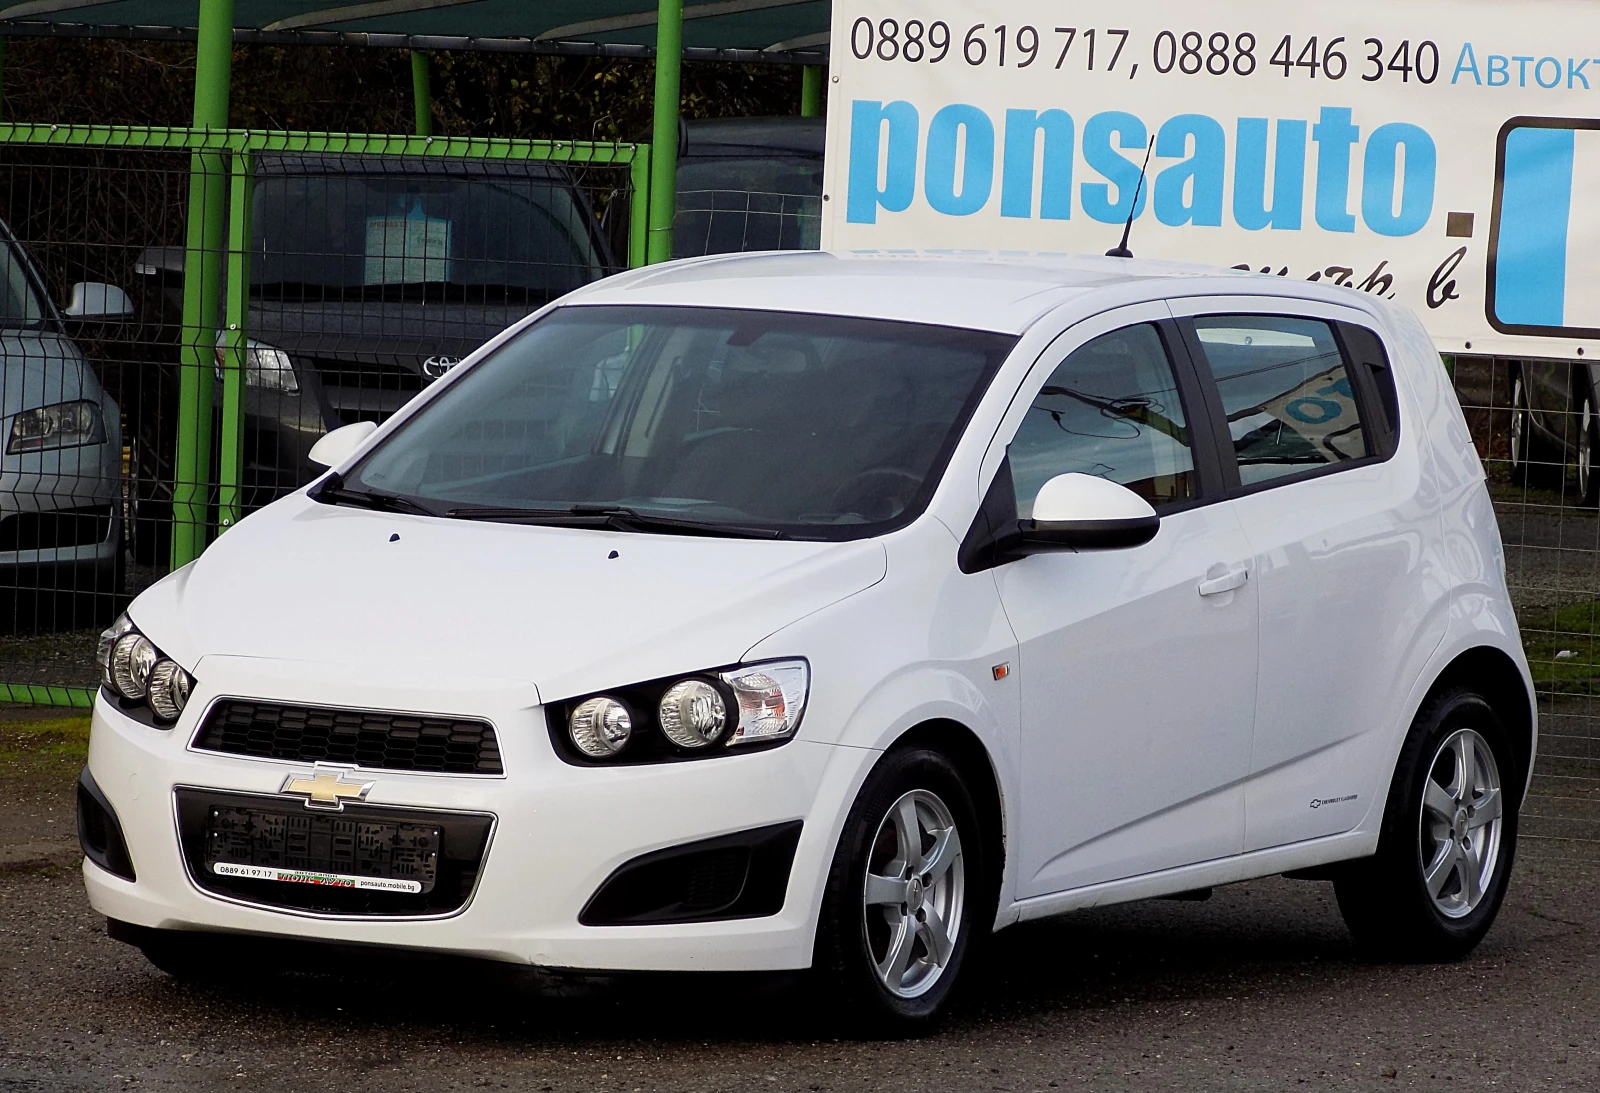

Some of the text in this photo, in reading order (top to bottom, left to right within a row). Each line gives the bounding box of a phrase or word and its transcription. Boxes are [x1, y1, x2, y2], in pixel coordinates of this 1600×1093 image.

[851, 16, 950, 64] 0889
[963, 23, 1039, 69] 619
[1054, 27, 1138, 80] 717,
[1153, 30, 1257, 76] 0888
[1269, 34, 1348, 80] 446
[1361, 38, 1440, 84] 340
[220, 866, 238, 874] 0889
[251, 869, 261, 877] 97
[360, 880, 415, 891] ponsauto.mobile.bg
